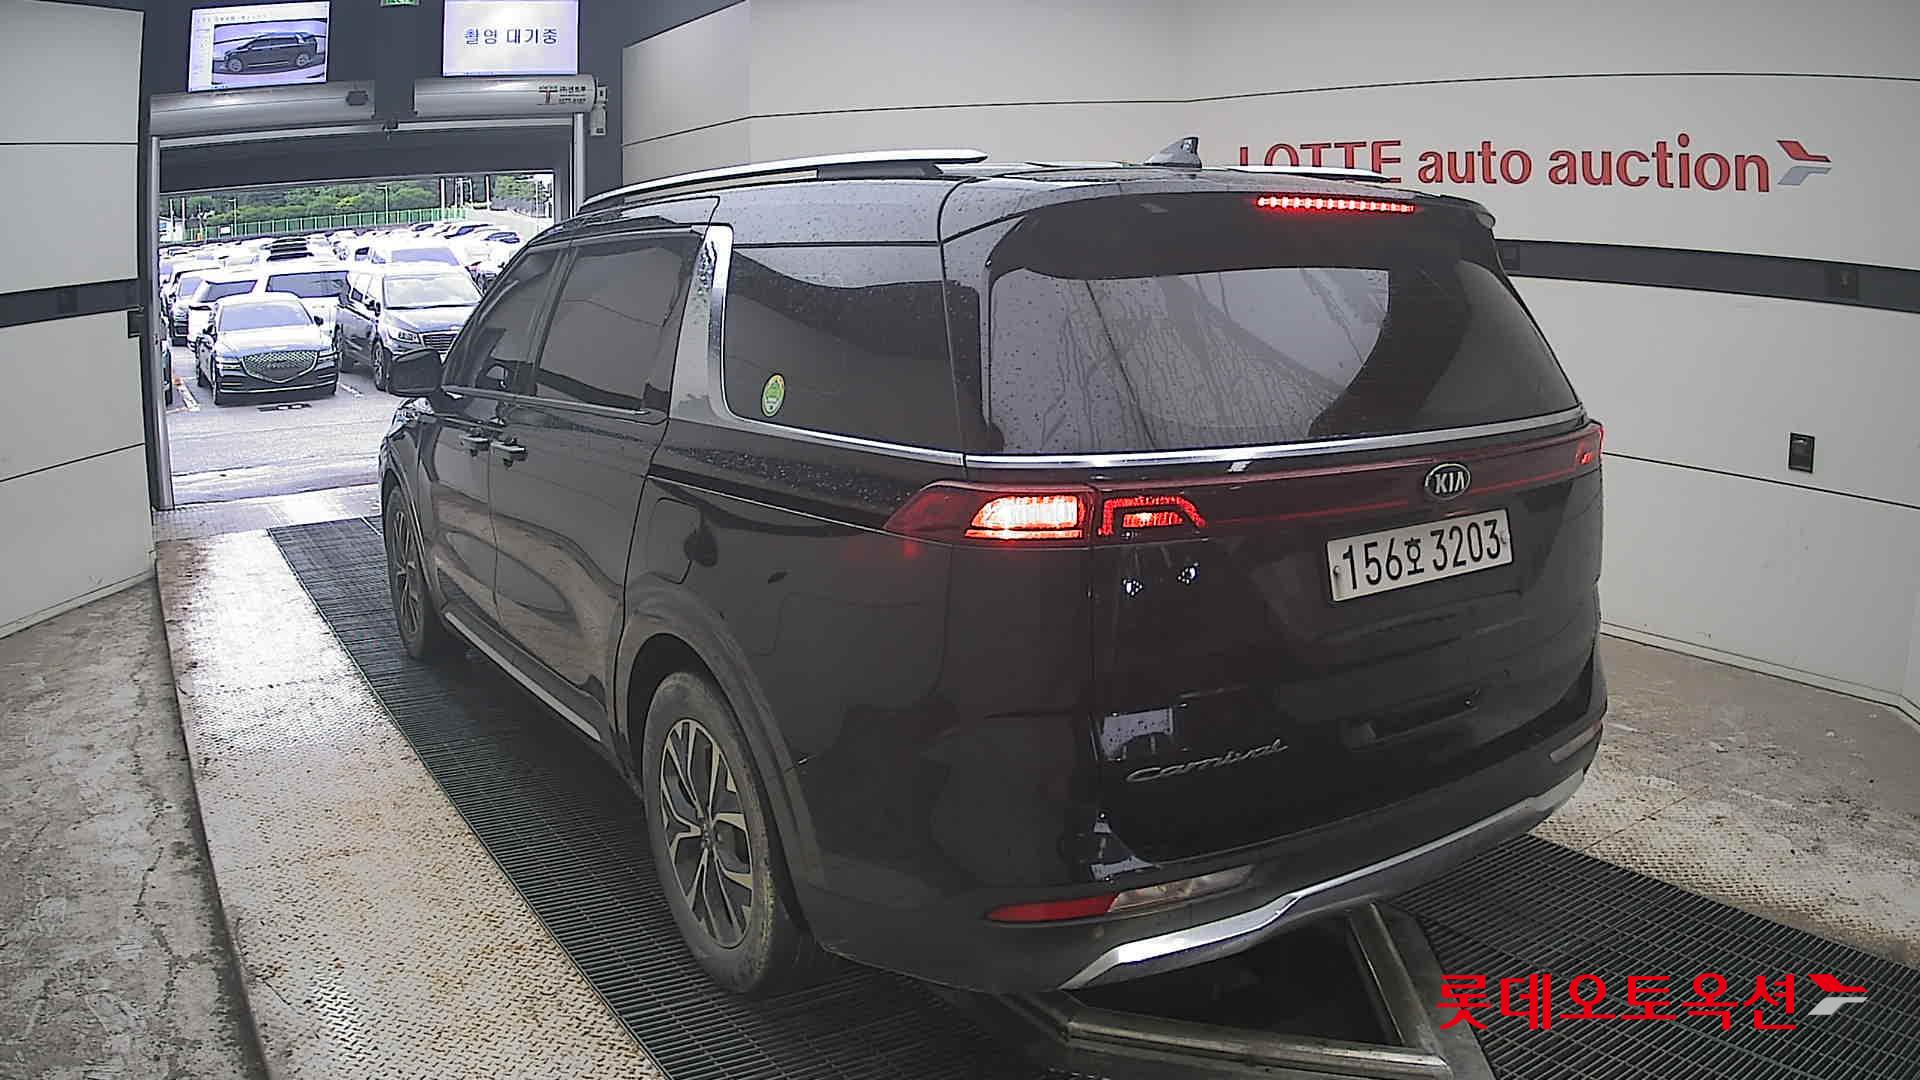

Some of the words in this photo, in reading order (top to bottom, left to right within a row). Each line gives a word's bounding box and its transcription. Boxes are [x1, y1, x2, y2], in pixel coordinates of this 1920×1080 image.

[506, 28, 558, 45] 대기중
[1417, 141, 1533, 185] auto
[1548, 133, 1770, 192] auction
[1434, 471, 1466, 494] KIA
[1342, 536, 1425, 592] 156호
[1430, 518, 1502, 572] 3203
[1126, 738, 1289, 783] Carnival
